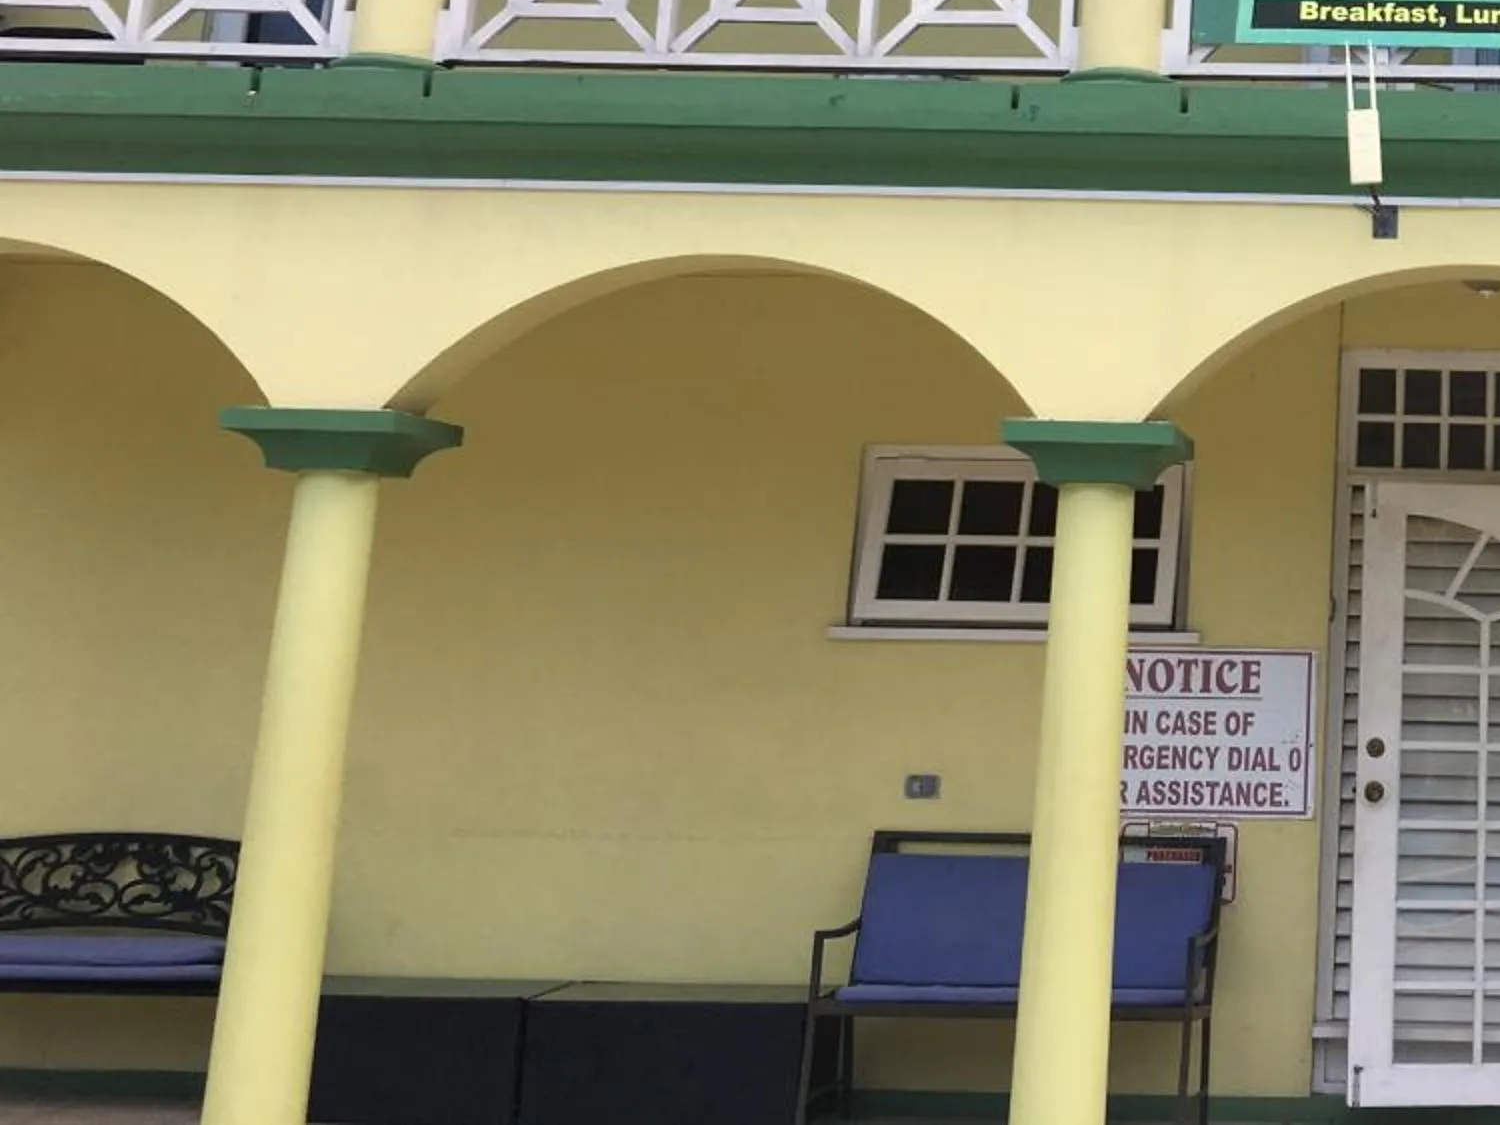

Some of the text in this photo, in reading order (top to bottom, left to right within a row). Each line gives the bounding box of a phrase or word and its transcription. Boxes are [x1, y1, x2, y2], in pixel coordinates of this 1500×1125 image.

[1299, 1, 1447, 27] Breakfast,
[1125, 659, 1261, 693] NOTICE
[1124, 710, 1255, 736] IN CASE OF
[1123, 745, 1219, 771] RGENCY
[1227, 747, 1281, 771] DIAL
[1136, 780, 1289, 807] ASSISTANCE.
